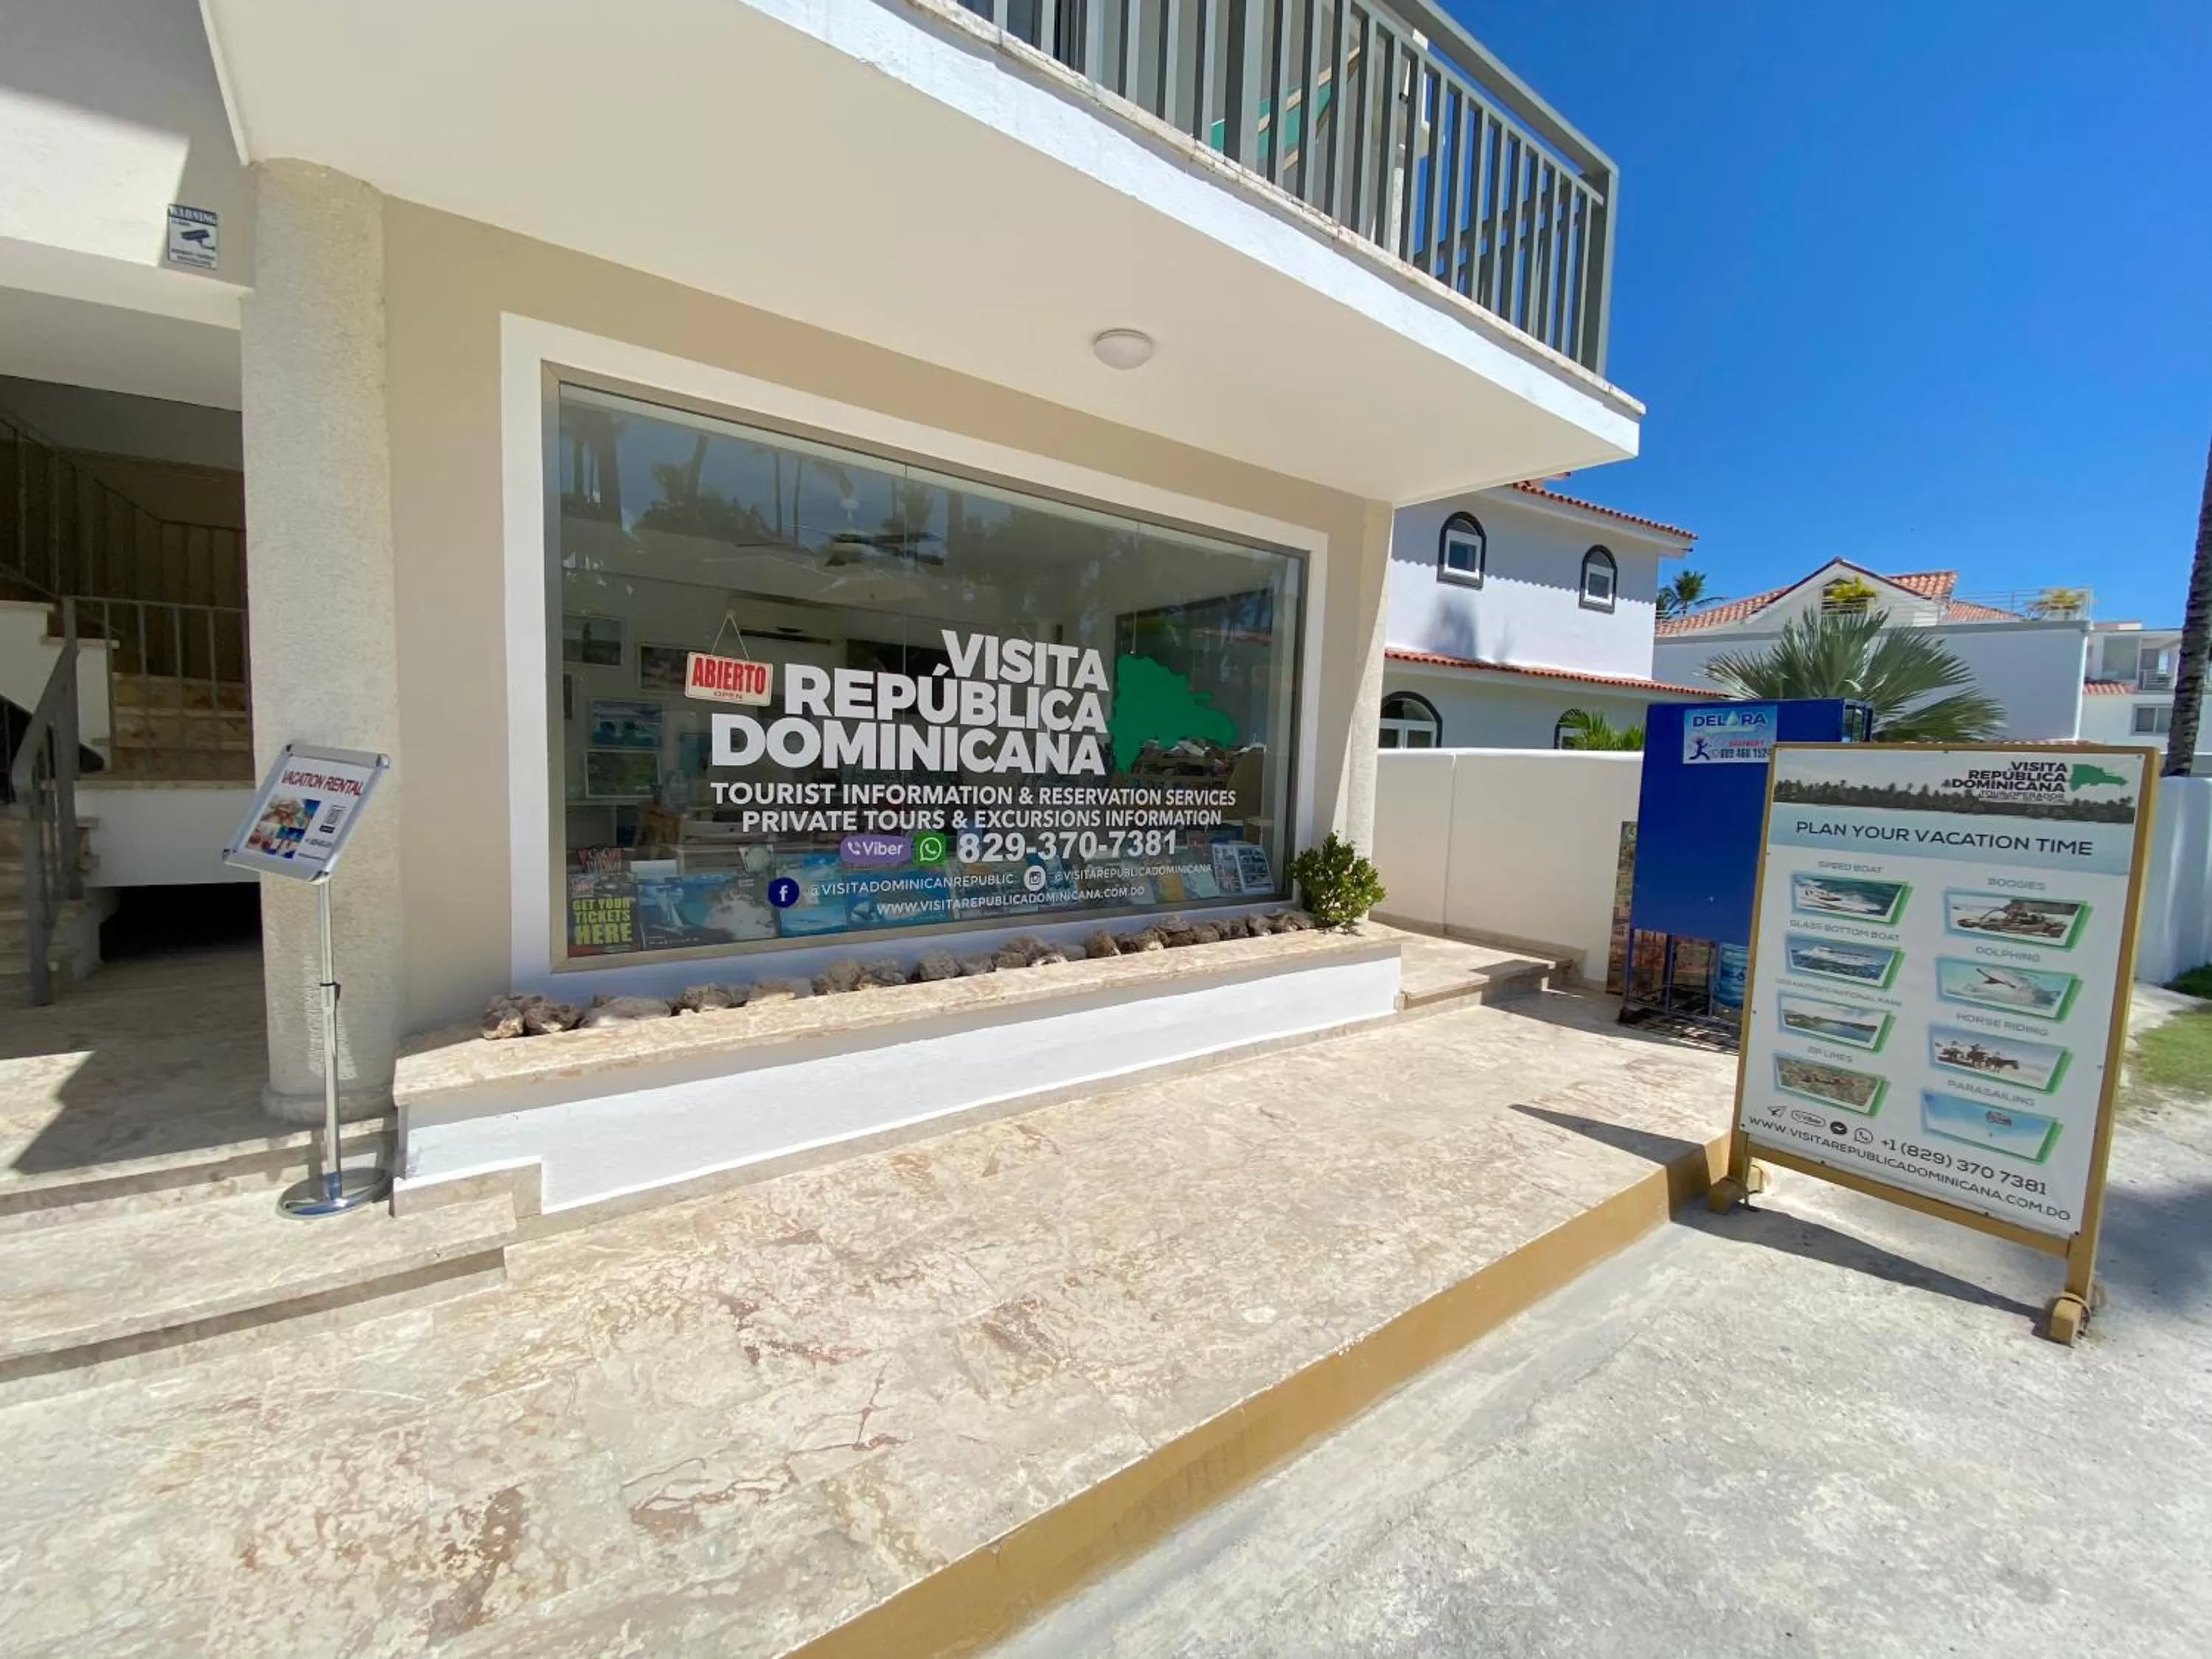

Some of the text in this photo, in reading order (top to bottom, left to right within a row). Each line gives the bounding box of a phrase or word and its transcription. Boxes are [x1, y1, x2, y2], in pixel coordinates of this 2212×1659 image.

[942, 629, 1109, 691] VISITA
[692, 657, 766, 695] ABIERTO
[714, 691, 743, 700] OPEN
[785, 663, 1108, 734] REPÚBLICA
[712, 713, 1106, 776] DOMINICANA
[2011, 761, 2068, 773] VISITA
[281, 770, 364, 796] VACATION RENTAL
[711, 782, 1236, 806] TOURIST INFORMATION & RESERVATION SERVICES
[1952, 779, 2066, 793] DOMINICANA
[742, 810, 1222, 832] PRIVATE TOURS & EXCURSIONS INFORMATION
[863, 829, 1176, 863] Viber 829-370-7381
[1796, 821, 2093, 856] PLAN YOUR VACATION TIME
[809, 874, 1014, 896] @VISITADOMINICANREPUBLIC
[572, 897, 630, 911] GET YOUR
[877, 887, 1144, 915] WWW.VISITAREPUBLICADOMINICANA.COM.DO
[575, 910, 630, 924] TICKETS
[574, 923, 633, 944] HERE
[1790, 919, 1900, 942] GLASS BOTTOM BOAT
[1955, 1012, 2048, 1036] HORSE RIDING
[1947, 1079, 2035, 1107] PARASAILING
[1749, 1116, 2071, 1221] WWW.VISITAREPUBLICADOMINICANA.COM.DO
[1881, 1138, 1896, 1151] +1
[1900, 1142, 1952, 1169] (829)
[1956, 1159, 1994, 1180] 370
[1999, 1170, 2047, 1195] 7381
